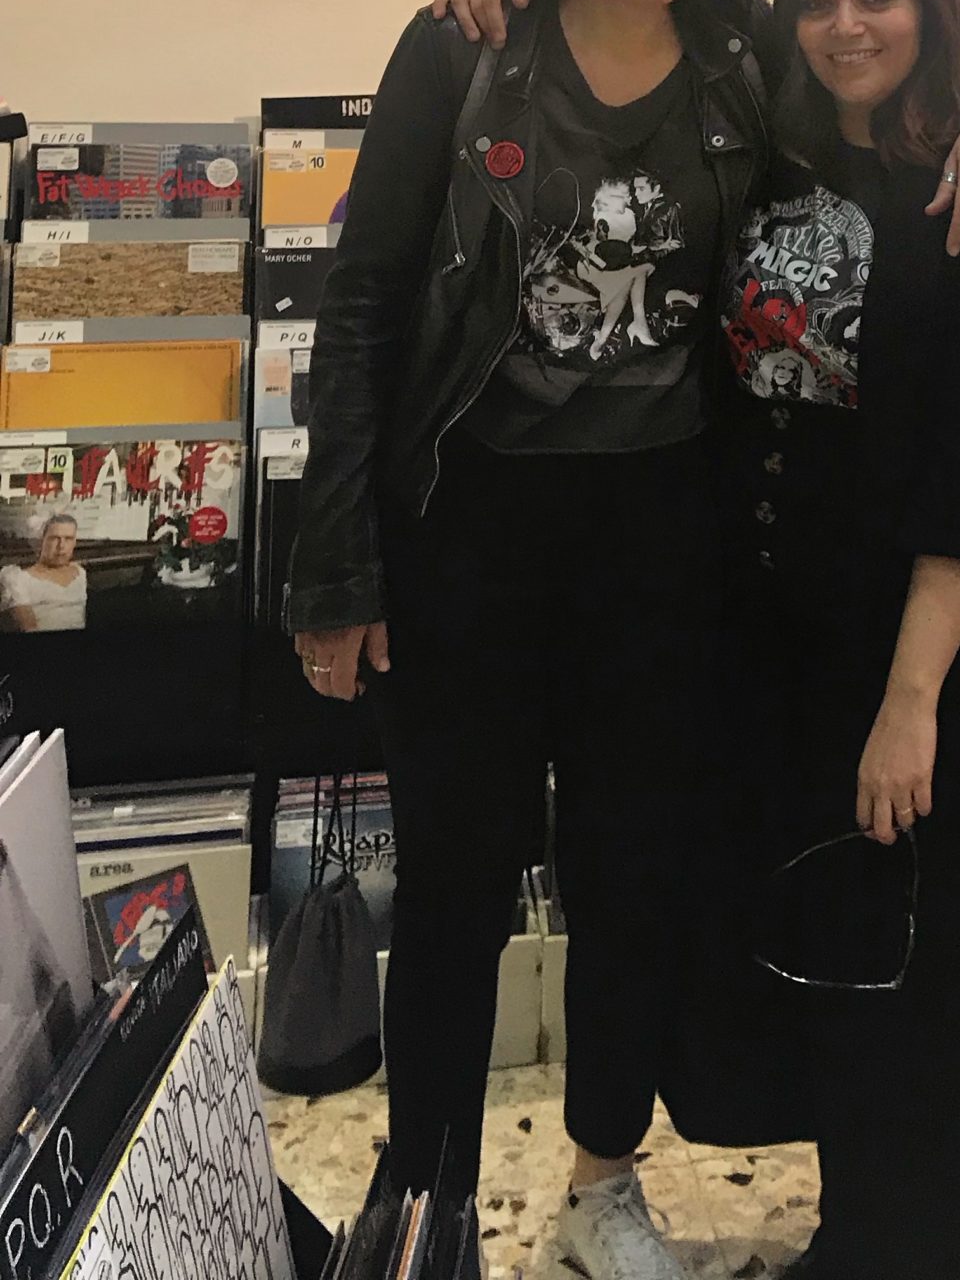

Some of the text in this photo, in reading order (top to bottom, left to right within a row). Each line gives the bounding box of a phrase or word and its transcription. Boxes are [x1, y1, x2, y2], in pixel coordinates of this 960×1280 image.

[291, 138, 304, 150] M
[310, 156, 325, 169] 10
[745, 239, 840, 294] MAGIC
[291, 438, 302, 450] R
[50, 453, 67, 469] 10
[89, 863, 134, 878] area
